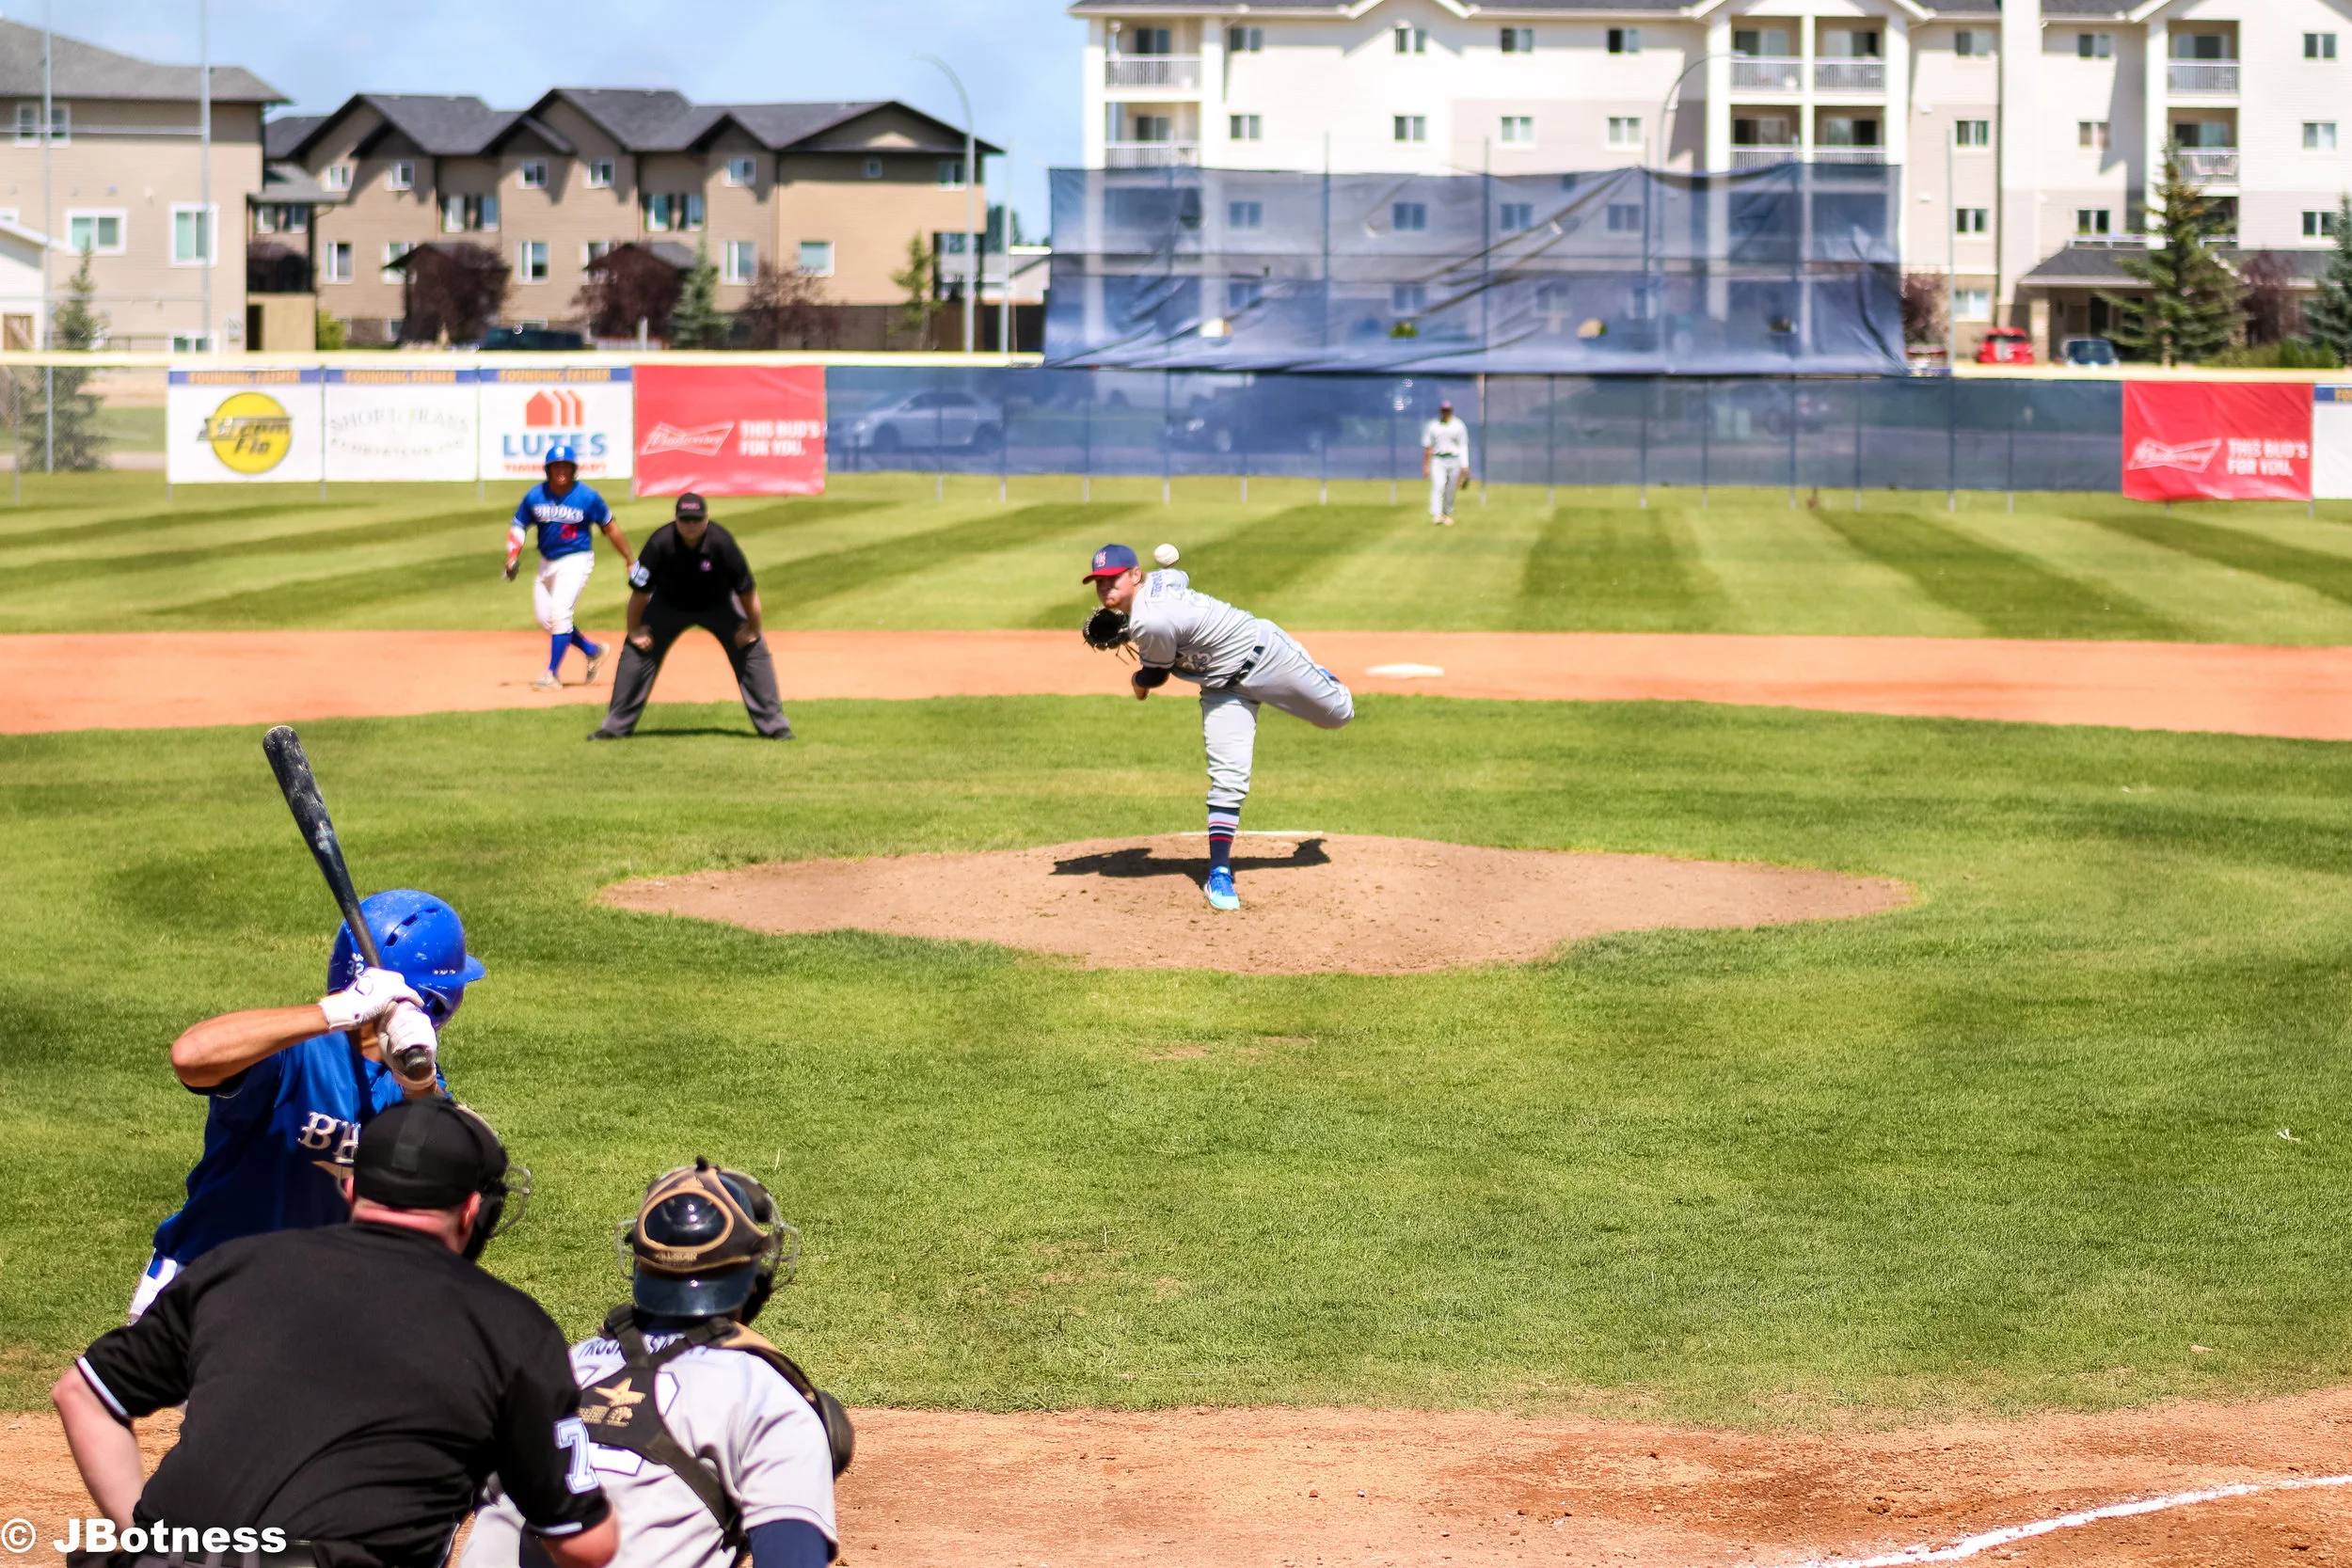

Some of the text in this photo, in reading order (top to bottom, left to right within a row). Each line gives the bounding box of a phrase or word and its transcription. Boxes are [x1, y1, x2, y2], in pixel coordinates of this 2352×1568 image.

[647, 427, 723, 447] Budweiser
[739, 420, 820, 438] THIS BUD'S
[739, 439, 770, 456] FOR
[2227, 438, 2309, 459] THIS BUD'S
[2227, 458, 2258, 475] FOR
[553, 1417, 599, 1494] 7
